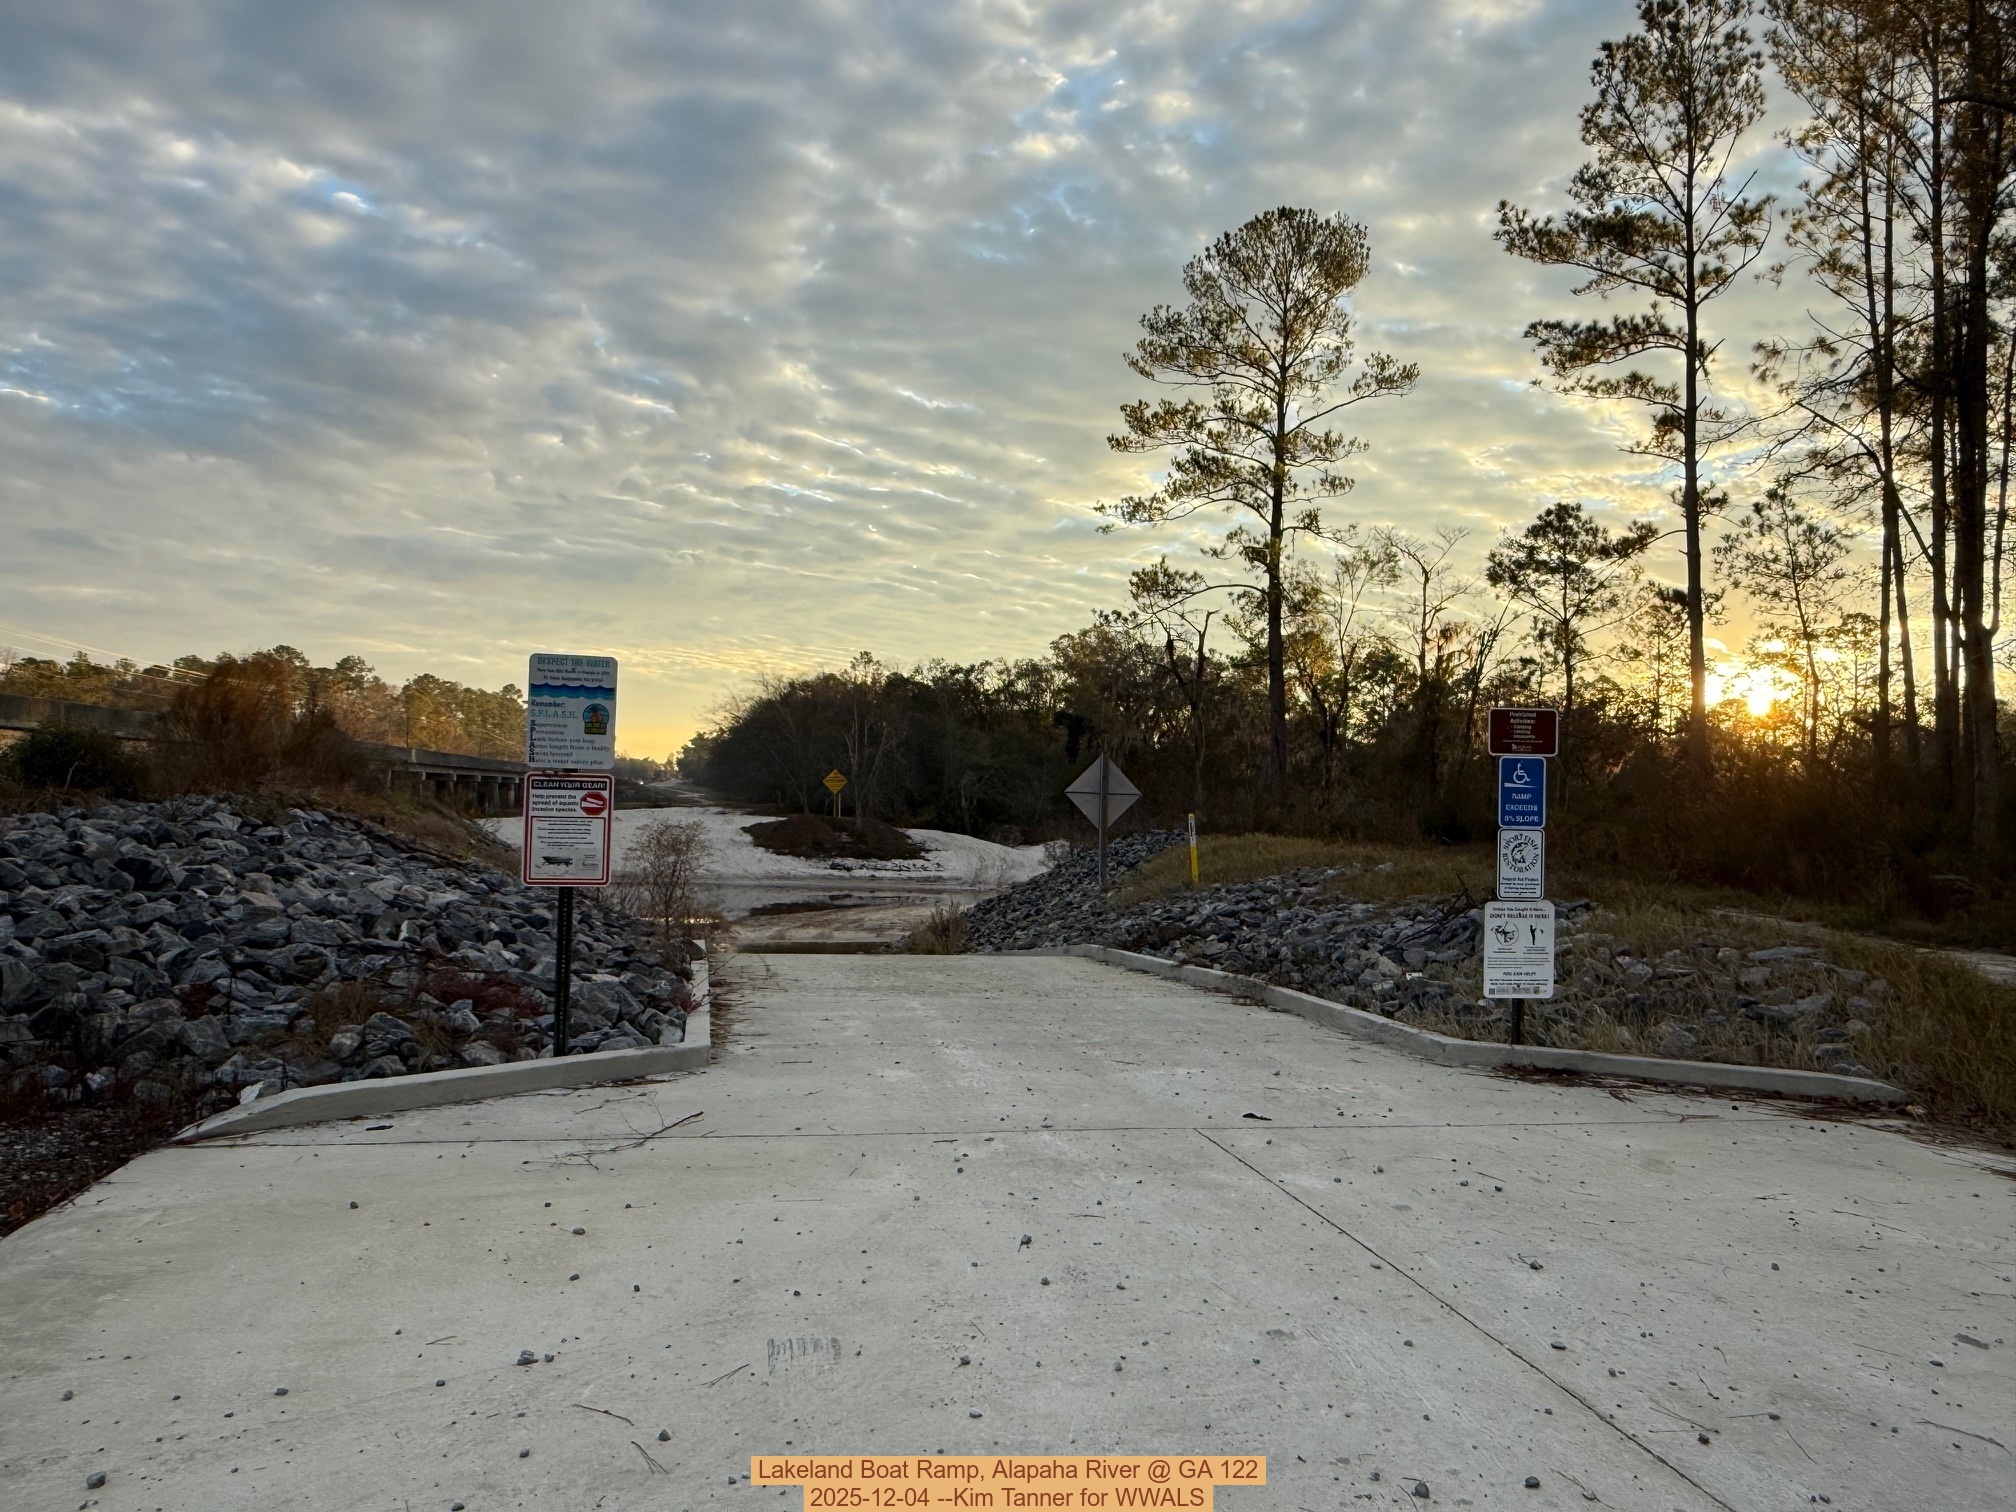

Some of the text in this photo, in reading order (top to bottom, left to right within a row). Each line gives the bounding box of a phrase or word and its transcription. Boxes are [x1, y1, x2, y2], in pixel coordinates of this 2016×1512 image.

[531, 700, 566, 708] Remember:
[1504, 834, 1539, 850] SPORT FISH
[1502, 853, 1539, 872] RESTORATION
